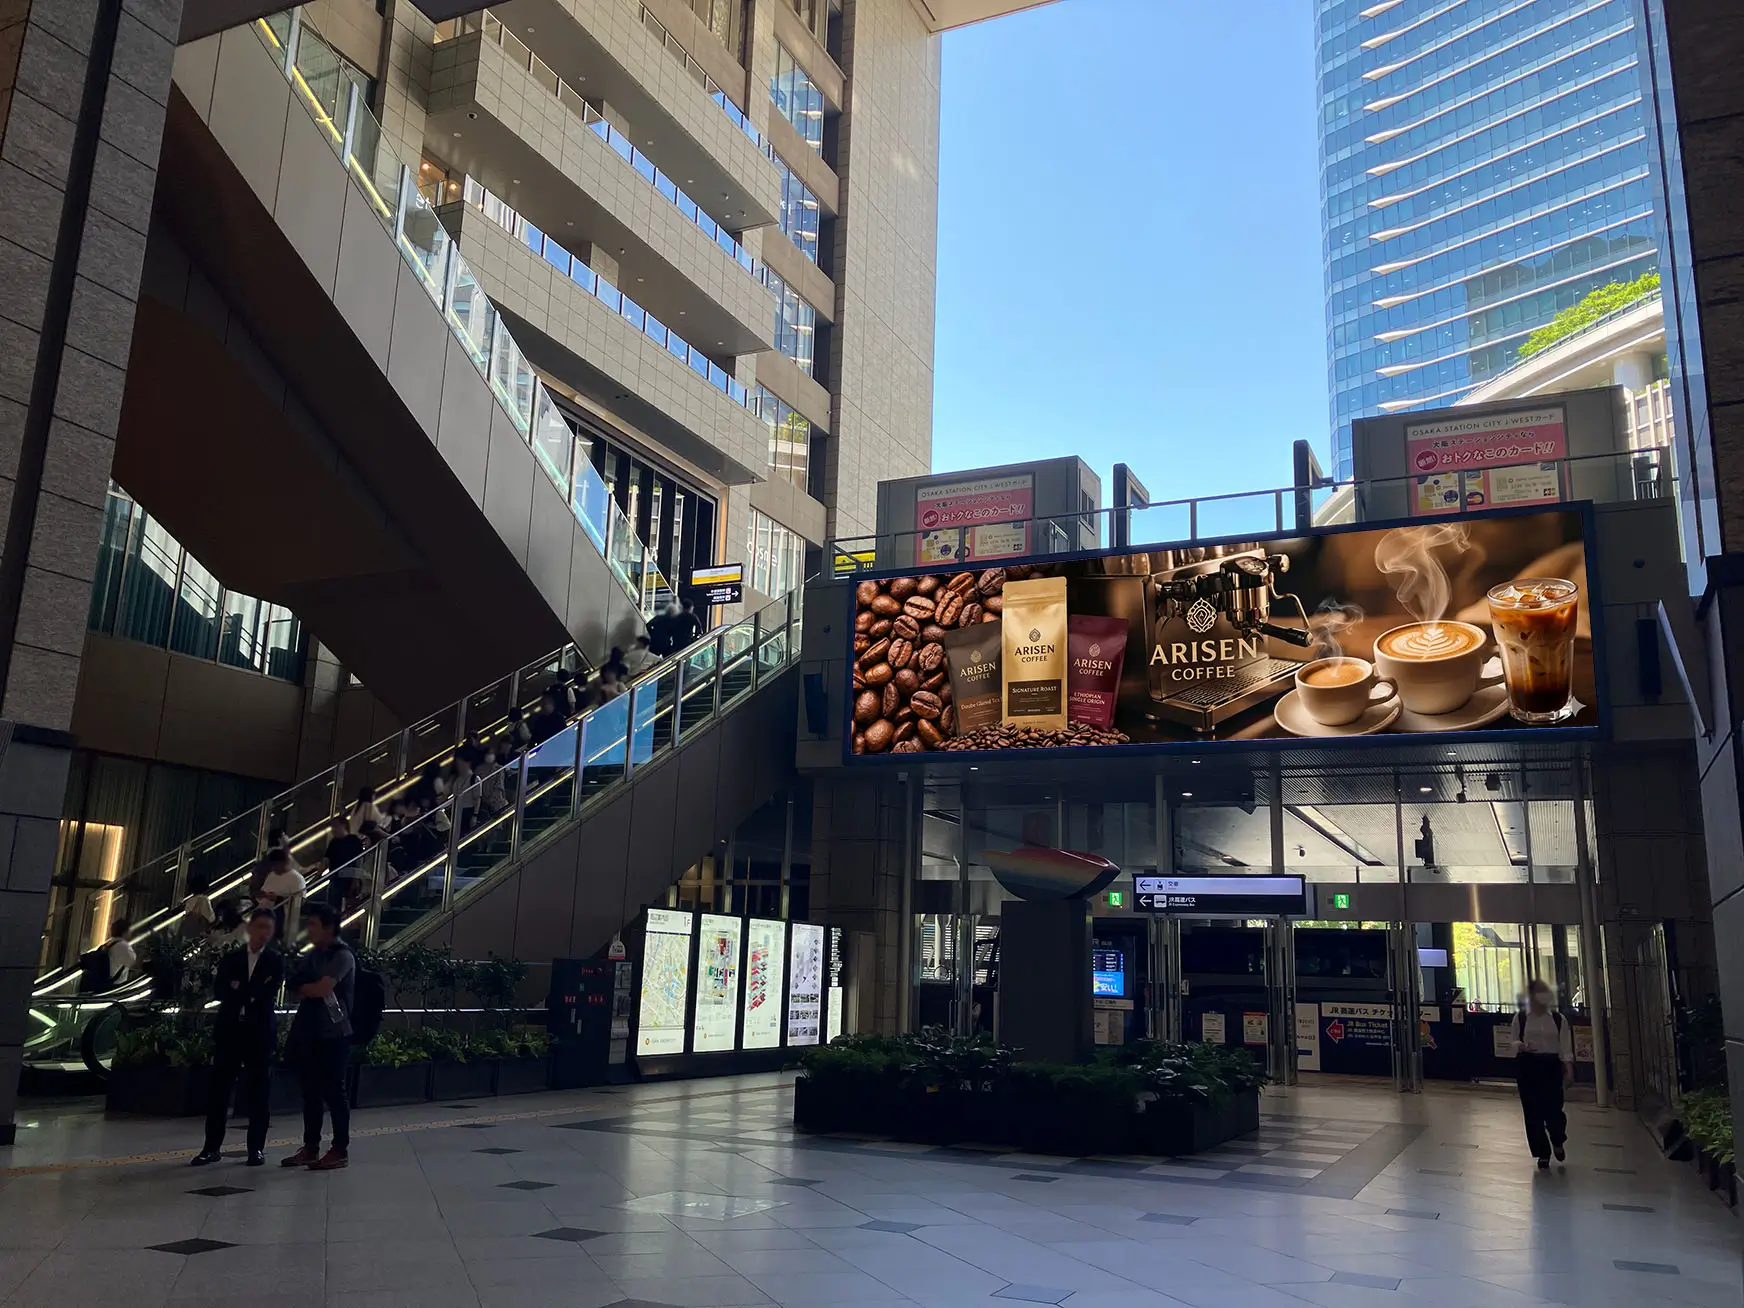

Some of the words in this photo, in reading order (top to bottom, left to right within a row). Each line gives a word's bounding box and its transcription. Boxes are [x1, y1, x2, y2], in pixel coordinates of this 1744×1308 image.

[1412, 427, 1441, 436] OSAKA
[1444, 423, 1480, 434] STATION
[1483, 420, 1502, 429] CITY
[945, 486, 972, 496] STATION
[974, 484, 989, 492] CITY
[1014, 644, 1055, 656] ARISEN
[1149, 636, 1258, 666] ARISEN
[1021, 655, 1048, 663] COFFEE
[1073, 658, 1112, 671] ARISEN
[959, 661, 997, 678] ARISEN
[1079, 668, 1104, 677] COFFEE
[1171, 665, 1236, 682] COFFEE
[966, 672, 991, 683] COFFEE
